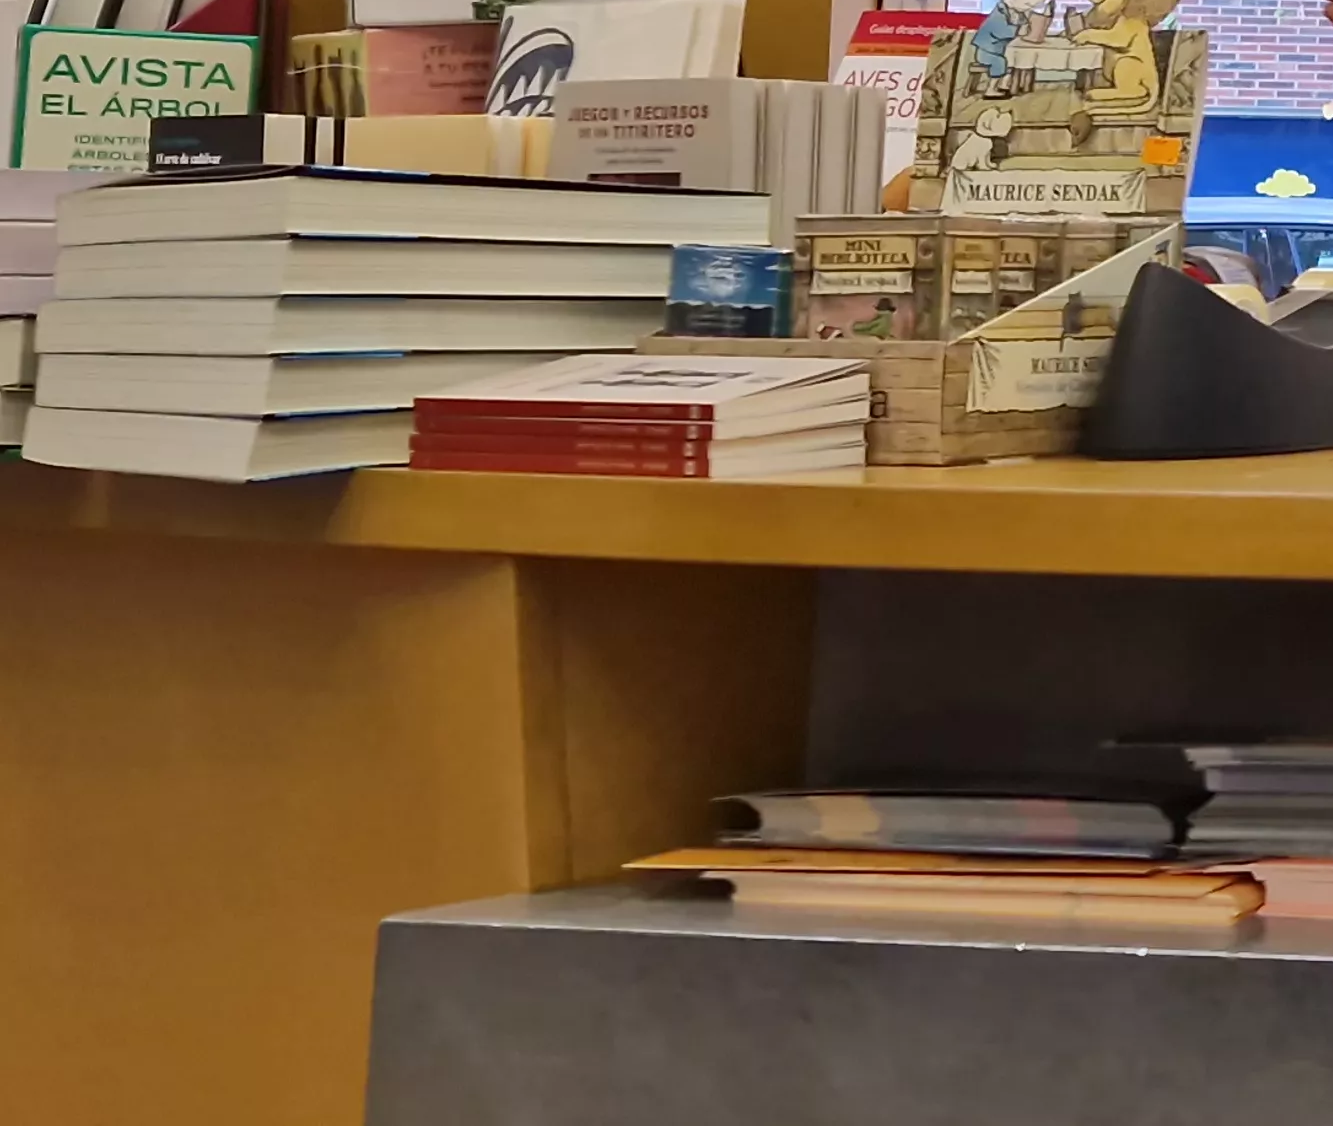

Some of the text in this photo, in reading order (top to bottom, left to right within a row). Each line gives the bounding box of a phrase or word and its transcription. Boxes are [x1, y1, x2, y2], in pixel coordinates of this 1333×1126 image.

[42, 53, 236, 91] AVISTA
[844, 70, 924, 92] AVES d
[41, 91, 221, 118] EL ÁRBOL
[633, 105, 709, 121] RECURSOS
[613, 124, 695, 139] TITIRITERO
[74, 134, 150, 146] IDENTIFI
[967, 184, 1123, 202] MAURICE SENDAK
[845, 239, 882, 251] MINI
[820, 252, 910, 265] BIBLIOTECA
